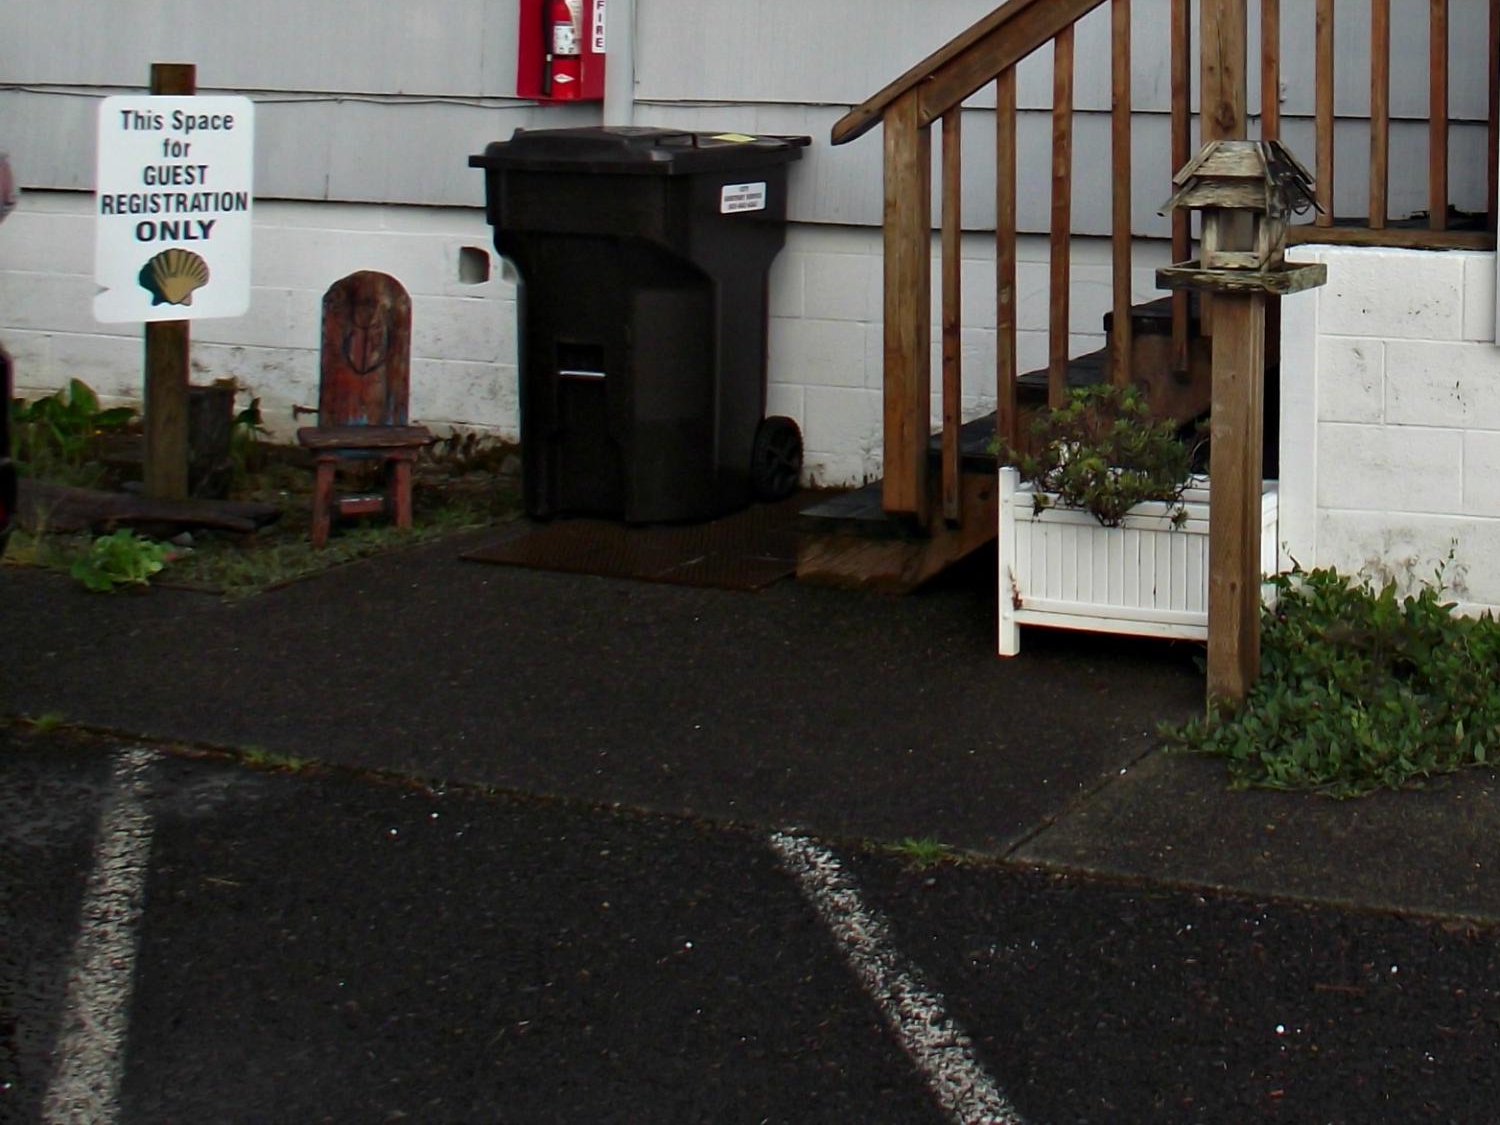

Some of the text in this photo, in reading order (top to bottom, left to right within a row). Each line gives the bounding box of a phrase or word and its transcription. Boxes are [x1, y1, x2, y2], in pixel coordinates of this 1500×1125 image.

[595, 0, 605, 48] FIRE
[121, 109, 234, 135] This Space
[163, 138, 191, 158] for
[143, 165, 209, 186] GUEST
[101, 192, 248, 215] REGISTRATION
[136, 220, 217, 243] ONLY
